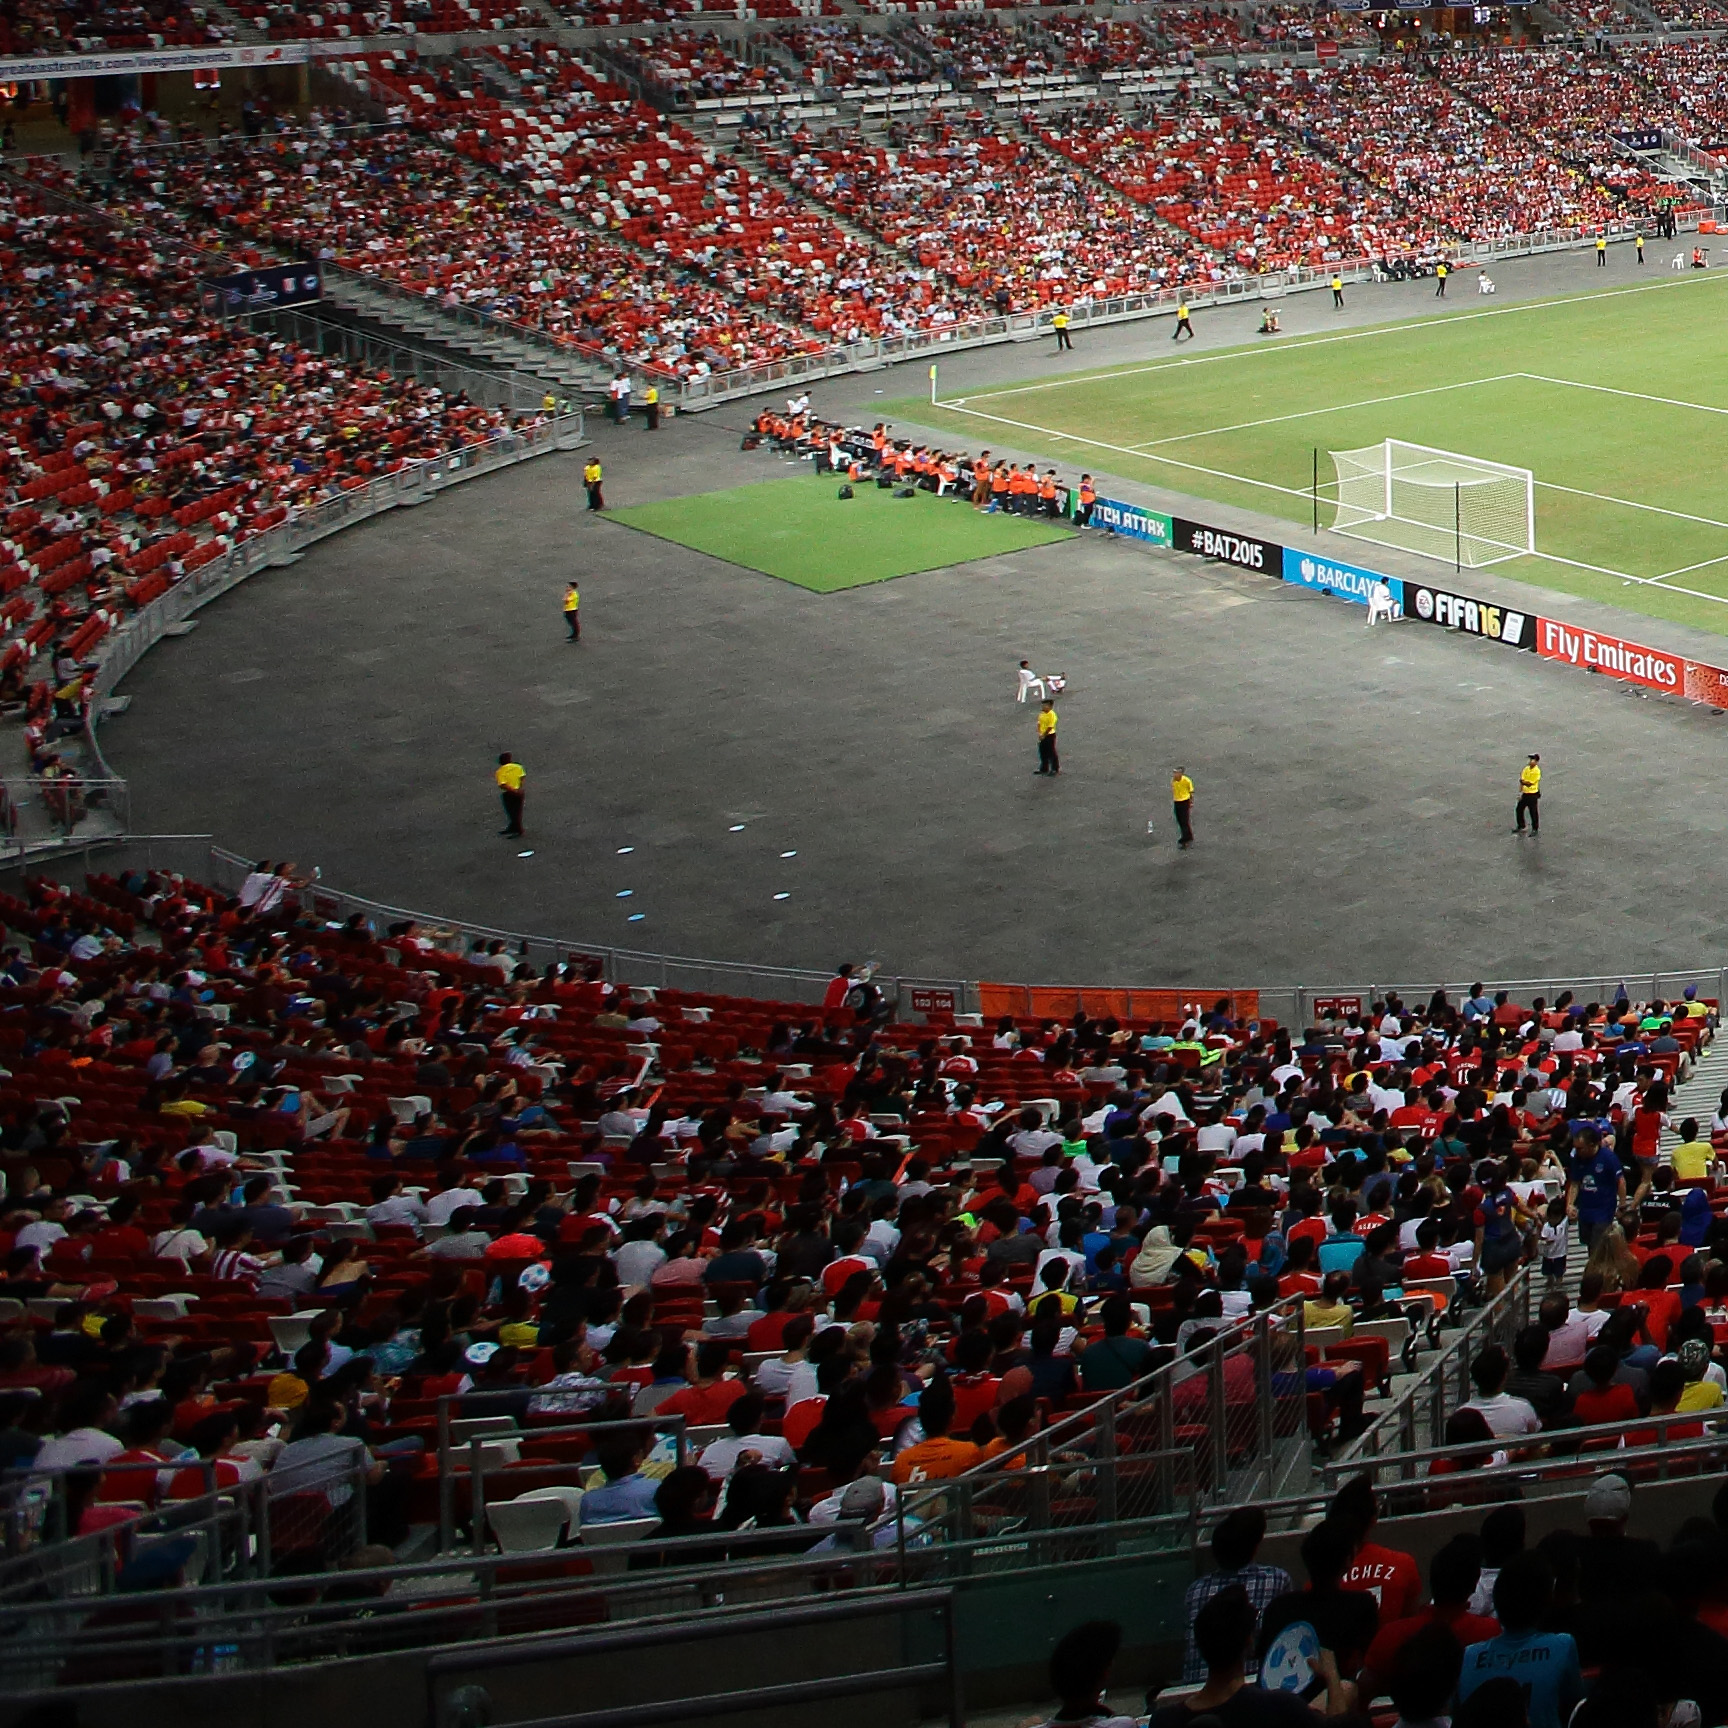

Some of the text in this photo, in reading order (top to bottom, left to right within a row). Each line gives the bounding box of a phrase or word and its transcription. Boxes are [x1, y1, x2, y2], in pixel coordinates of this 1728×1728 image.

[1121, 512, 1166, 538] ATTAX
[1192, 530, 1264, 569] #BAT2015
[1545, 622, 1677, 686] Fly Emirates
